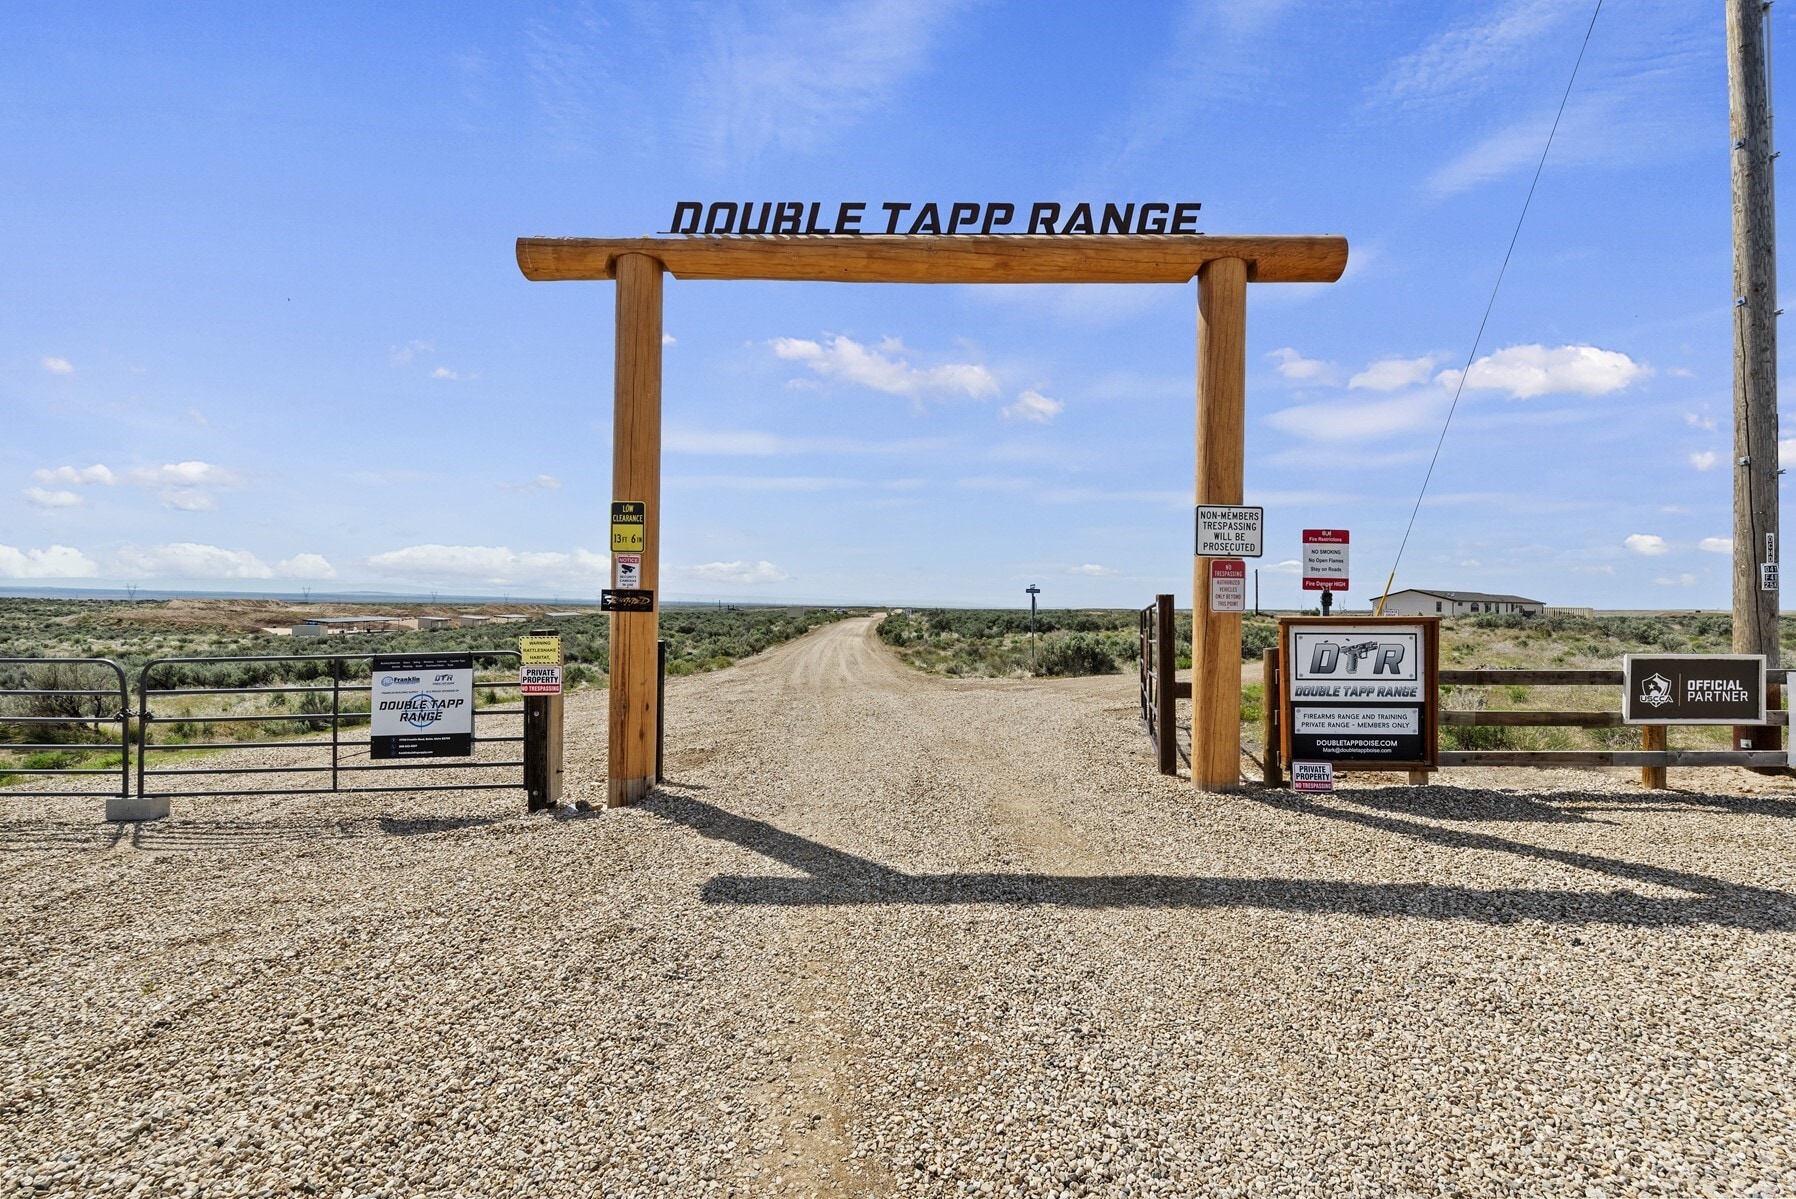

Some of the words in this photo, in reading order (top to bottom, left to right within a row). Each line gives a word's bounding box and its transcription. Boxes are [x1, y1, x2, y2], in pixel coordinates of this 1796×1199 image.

[670, 202, 866, 234] DOUBLE
[882, 202, 1015, 234] TAPP
[1028, 202, 1203, 234] RANGE
[1200, 511, 1259, 520] NON-MEMBERS
[1203, 522, 1256, 531] TRESPASSING
[614, 534, 621, 543] 13
[631, 534, 636, 543] 6
[1214, 532, 1232, 540] WILL
[1235, 533, 1245, 541] BE
[1203, 542, 1255, 551] PROSECUTED
[1688, 680, 1743, 690] OFFICIAL
[1295, 686, 1340, 697] DOUBLE
[1344, 686, 1374, 697] TAPP
[1377, 686, 1418, 697] RANGE
[1688, 691, 1748, 702] PARTNER
[379, 700, 427, 710] DOUBLE
[431, 699, 463, 708] TAPP
[400, 712, 442, 722] RANGE
